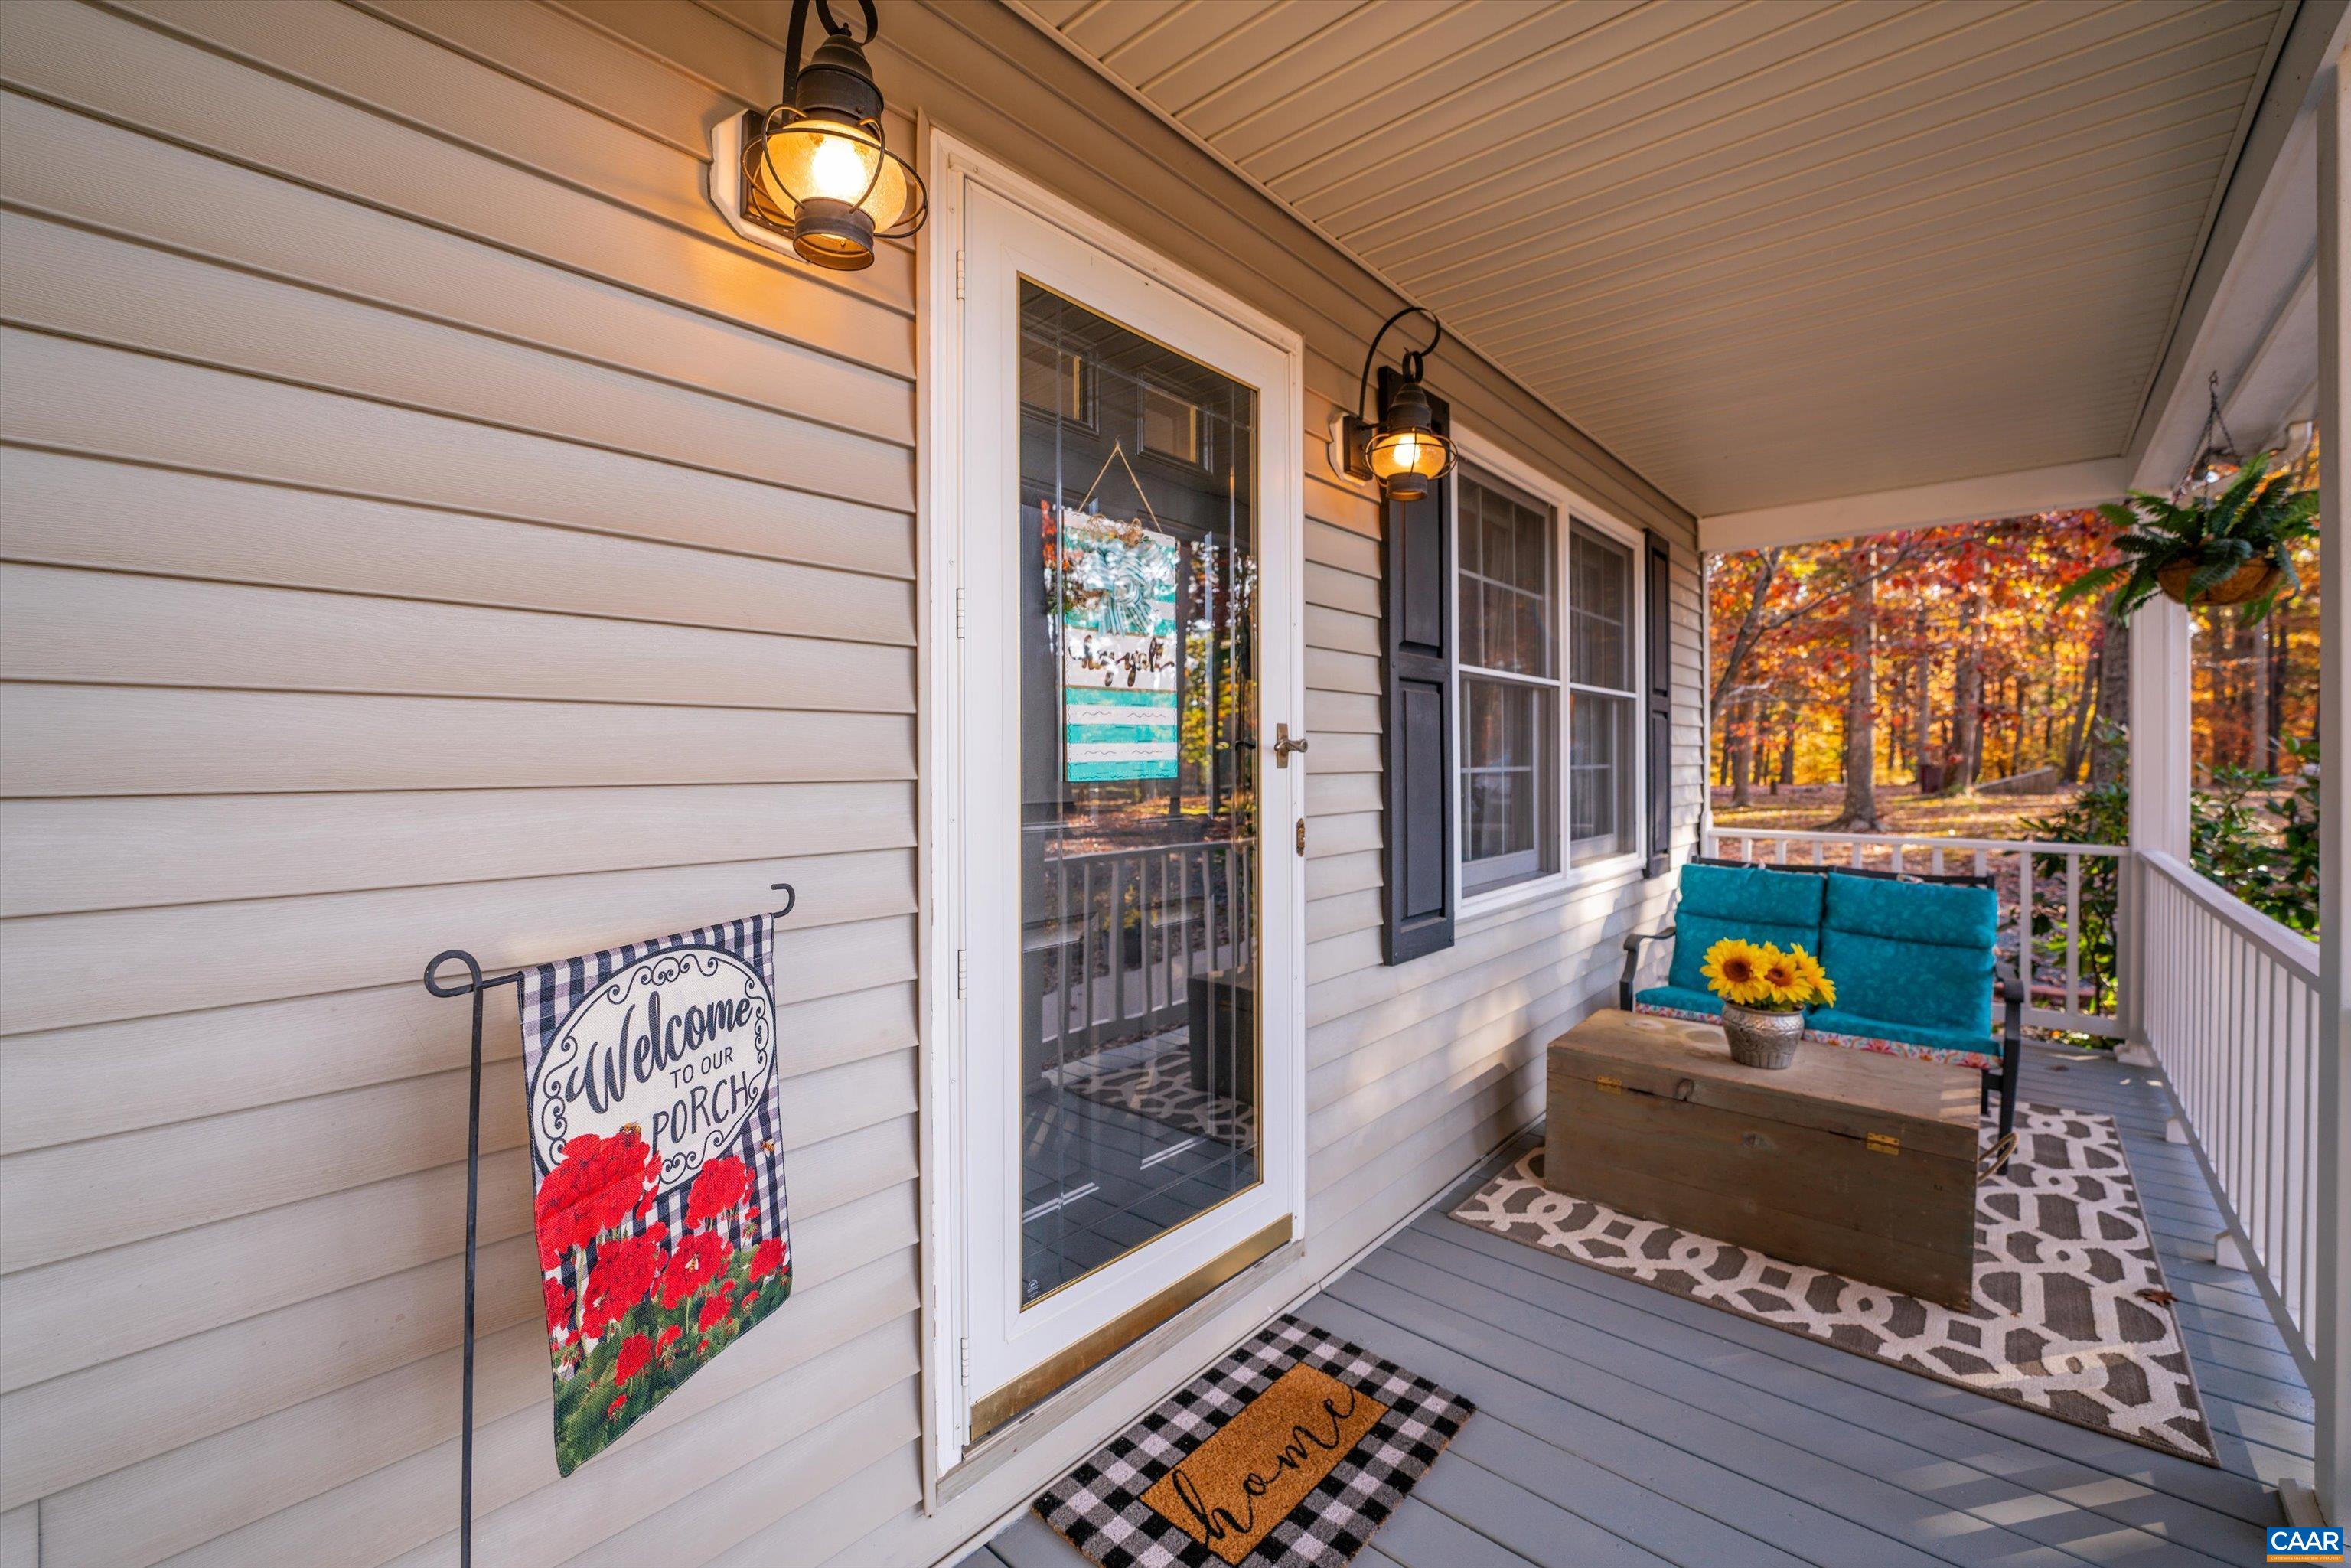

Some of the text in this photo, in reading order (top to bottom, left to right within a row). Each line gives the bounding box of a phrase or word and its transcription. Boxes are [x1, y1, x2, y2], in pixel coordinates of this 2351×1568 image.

[565, 991, 753, 1114] Welcome
[670, 1047, 734, 1088] TO OUR
[652, 1071, 749, 1155] PORCH
[1172, 1386, 1356, 1546] home
